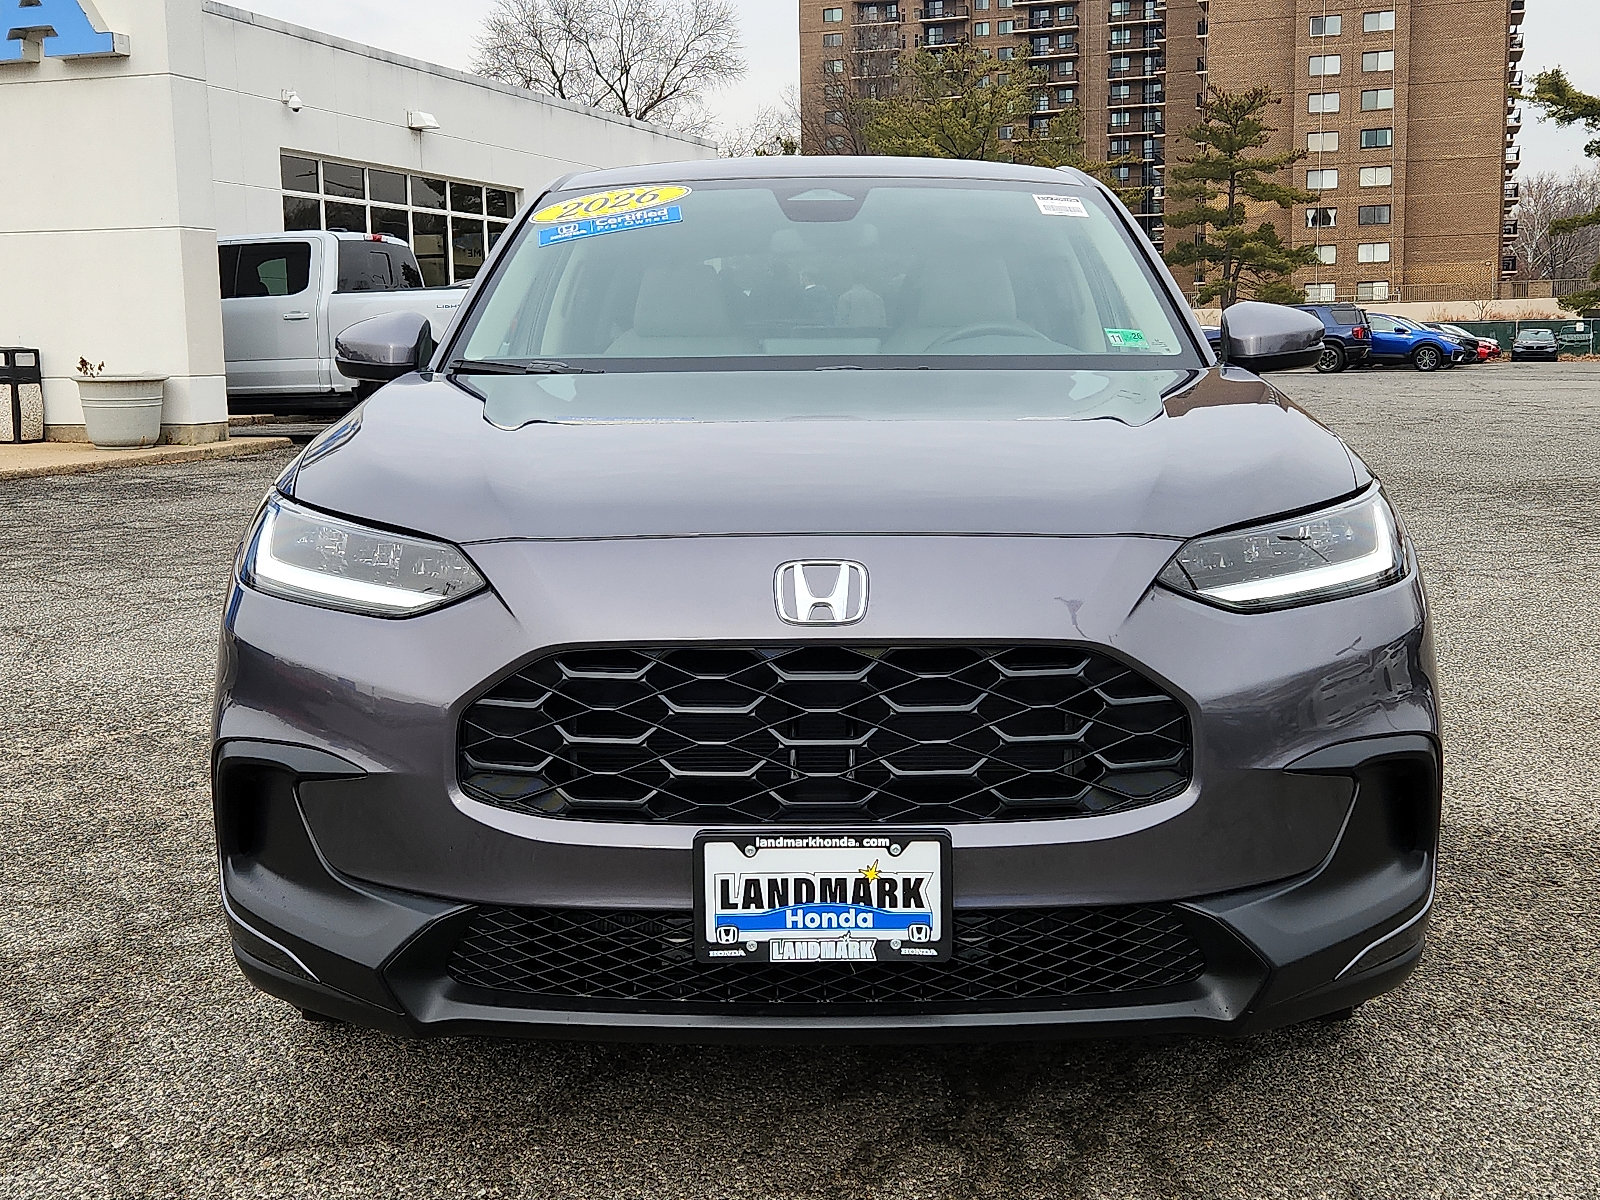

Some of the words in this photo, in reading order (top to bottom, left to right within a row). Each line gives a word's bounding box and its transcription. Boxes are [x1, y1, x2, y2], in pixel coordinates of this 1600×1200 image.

[556, 188, 660, 218] 2026
[595, 207, 669, 226] Certified
[719, 877, 926, 910] LANDMARK
[785, 909, 874, 929] Honda
[772, 938, 876, 961] LANDMARK
